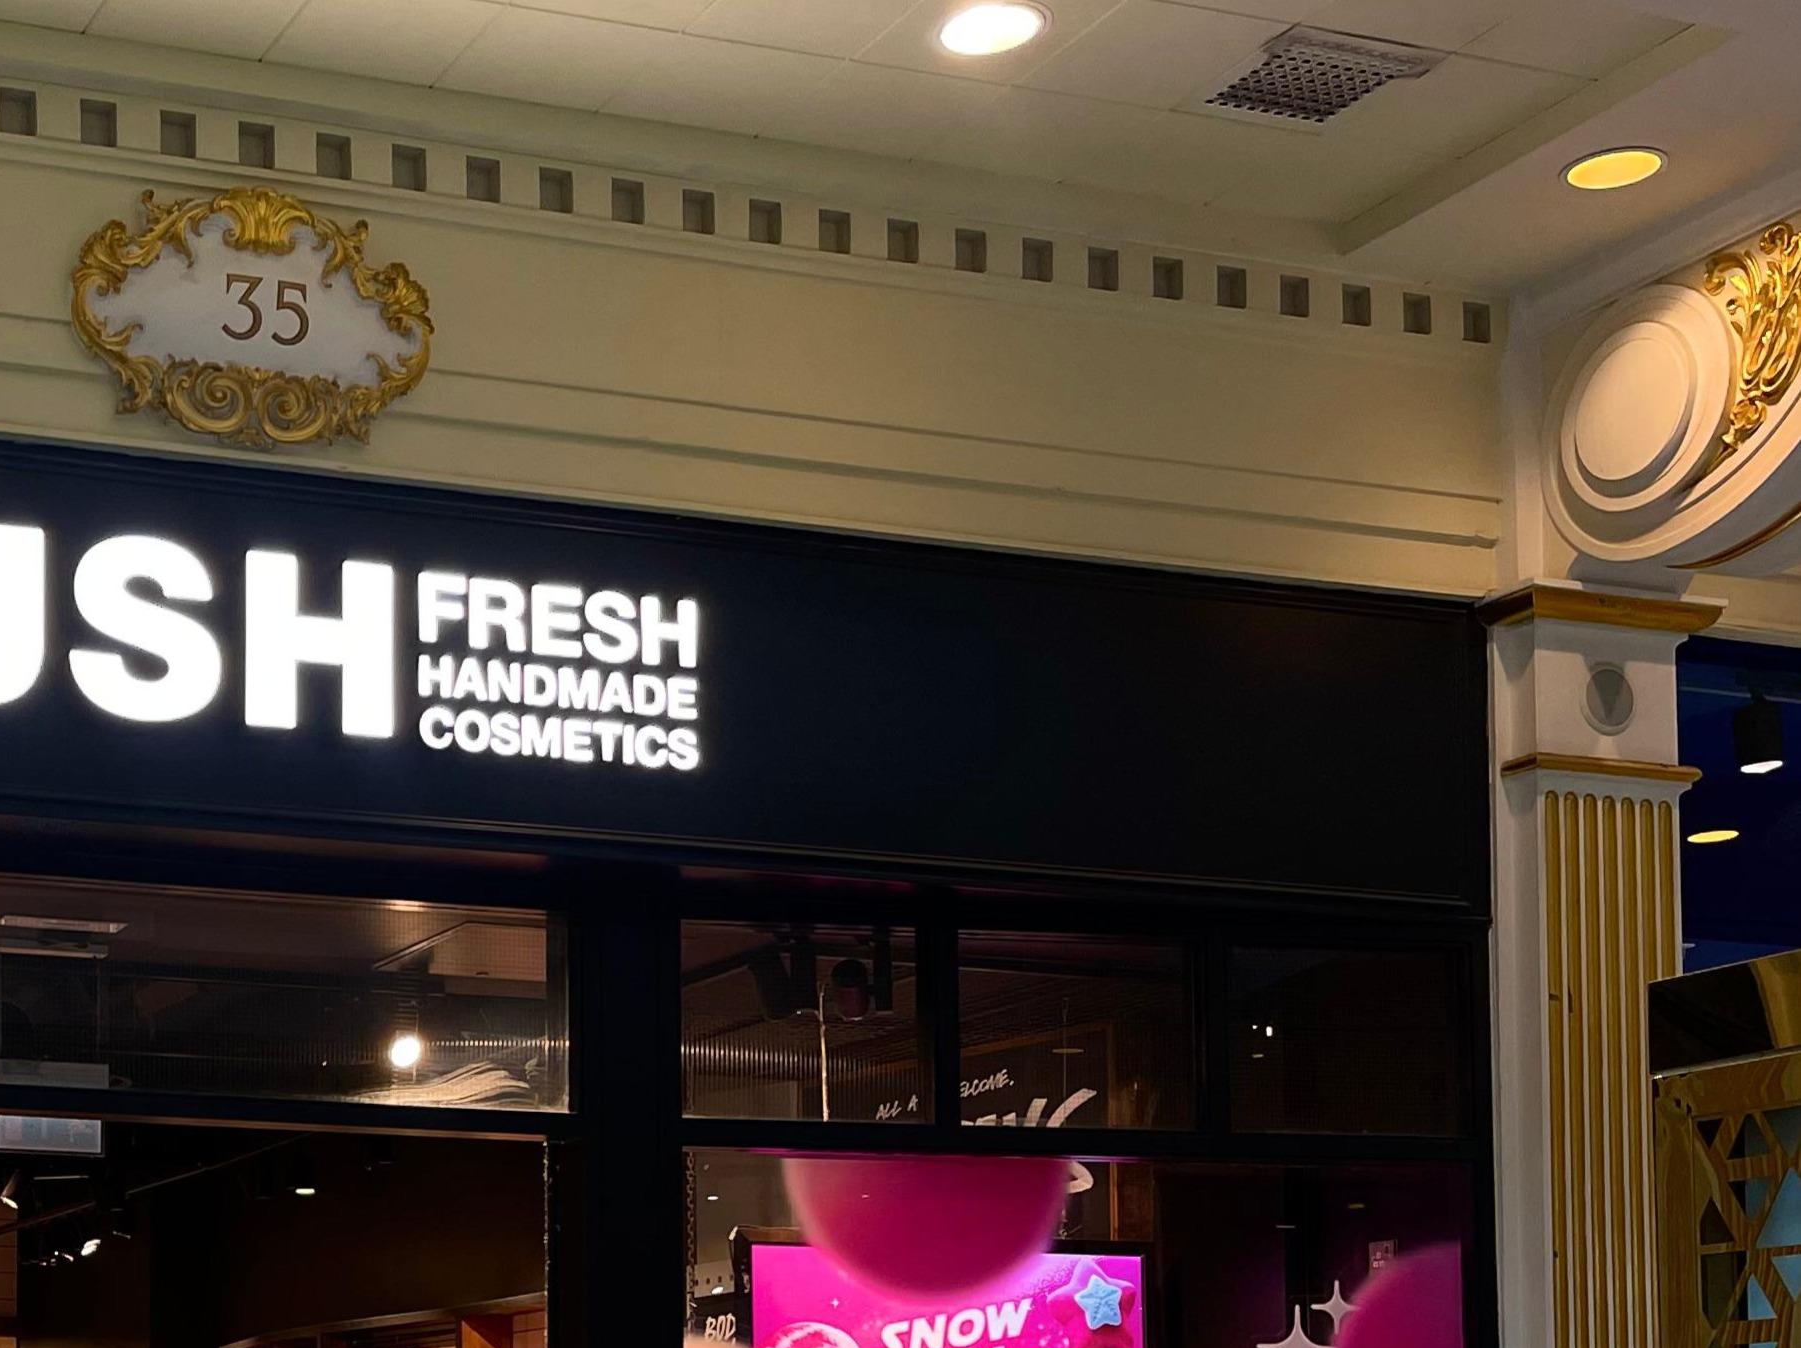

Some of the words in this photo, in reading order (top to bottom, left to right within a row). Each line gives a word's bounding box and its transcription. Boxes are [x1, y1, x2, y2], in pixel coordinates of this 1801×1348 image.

[220, 271, 311, 347] 35
[417, 569, 701, 669] FRESH
[417, 653, 699, 721] HANDMADE
[417, 704, 701, 771] COSMETICS
[875, 1100, 903, 1121] ALL
[960, 1068, 1015, 1097] ELCOME.
